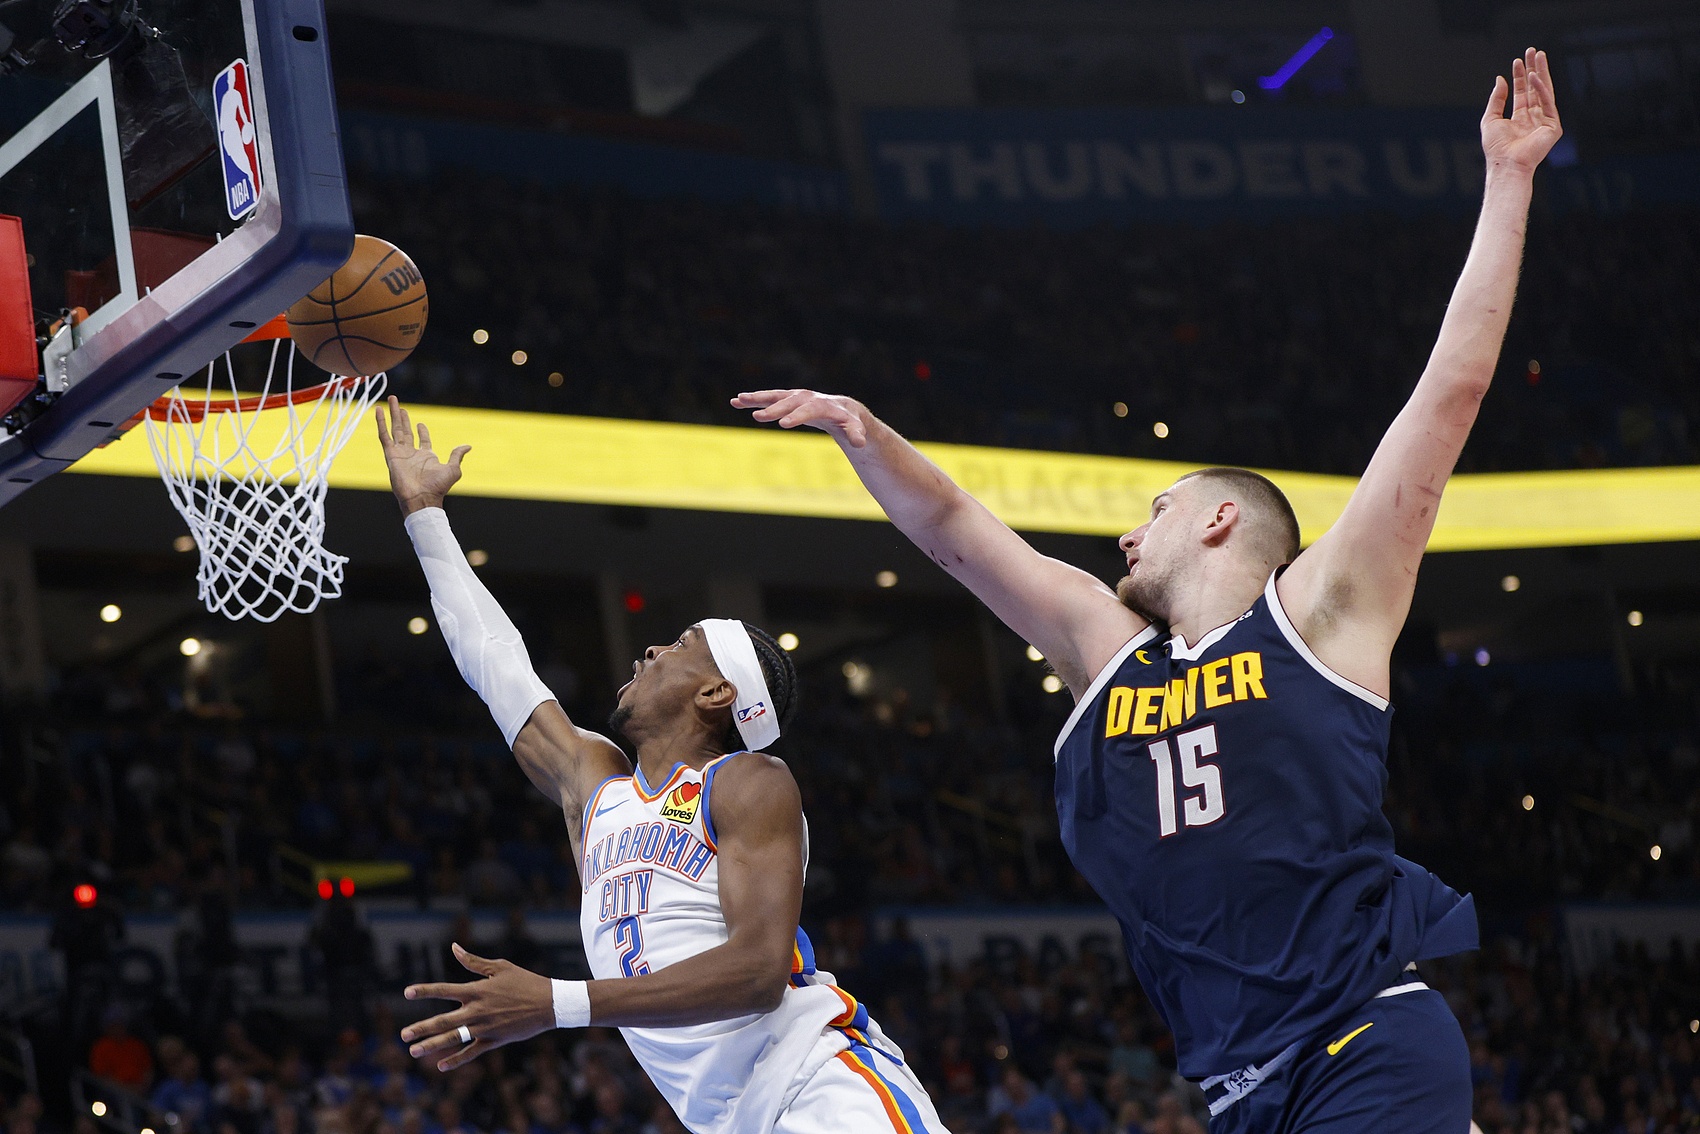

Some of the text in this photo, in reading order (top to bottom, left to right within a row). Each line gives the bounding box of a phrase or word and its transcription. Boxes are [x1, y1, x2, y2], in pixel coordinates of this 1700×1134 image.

[231, 178, 250, 210] NBA
[878, 142, 1369, 198] THUNDER
[958, 461, 1148, 520] PLACES
[1105, 651, 1268, 738] DENVER
[1146, 722, 1227, 839] 15
[584, 822, 715, 894] OKLAHOMA
[599, 869, 654, 922] CITY
[614, 915, 652, 978] 2
